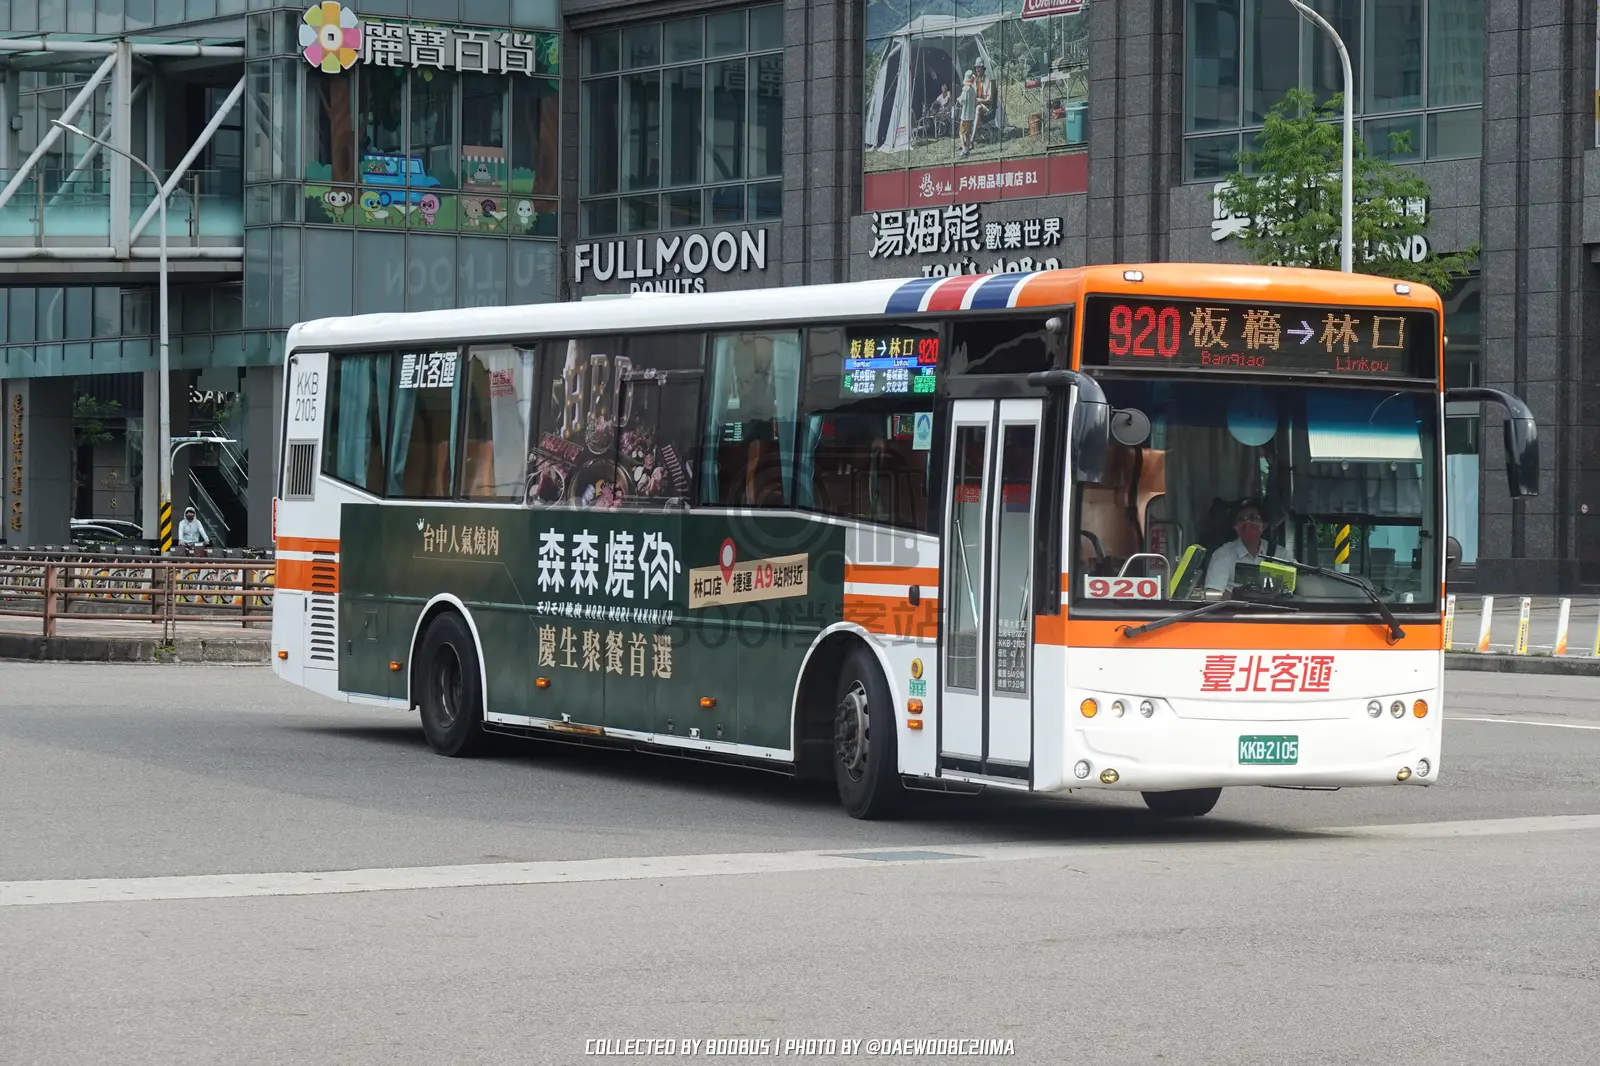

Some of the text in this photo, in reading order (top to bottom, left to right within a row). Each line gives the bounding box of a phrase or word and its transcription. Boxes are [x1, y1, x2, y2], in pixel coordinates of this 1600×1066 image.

[363, 22, 535, 76] 麗寶百貨
[959, 172, 1023, 191] 戶外用品專賣店
[1025, 171, 1038, 184] B1
[868, 203, 1061, 259] 湯姆熊 歡樂世界
[575, 229, 768, 283] FULLMOON
[1108, 304, 1406, 357] 920 板橋 林口
[850, 338, 914, 358] 板橋 林口
[918, 338, 939, 363] 920
[1201, 351, 1265, 368] Banqiao
[398, 351, 458, 389] 臺北客運
[1336, 356, 1390, 373] Linkou
[297, 371, 319, 396] KKB
[294, 398, 317, 422] 2105
[422, 523, 500, 557] 台中人氣燒肉
[537, 527, 681, 600] 森森燒肉
[694, 576, 722, 599] 林口店
[1088, 578, 1158, 598] 920
[585, 603, 606, 620] MORI
[608, 605, 630, 622] MORI
[633, 607, 673, 626] YAKINIKU
[537, 623, 673, 679] 慶生聚餐首選
[998, 638, 1026, 649] KKB-2105
[1200, 653, 1335, 692] 臺北客運
[1240, 741, 1298, 760] KKB-2105
